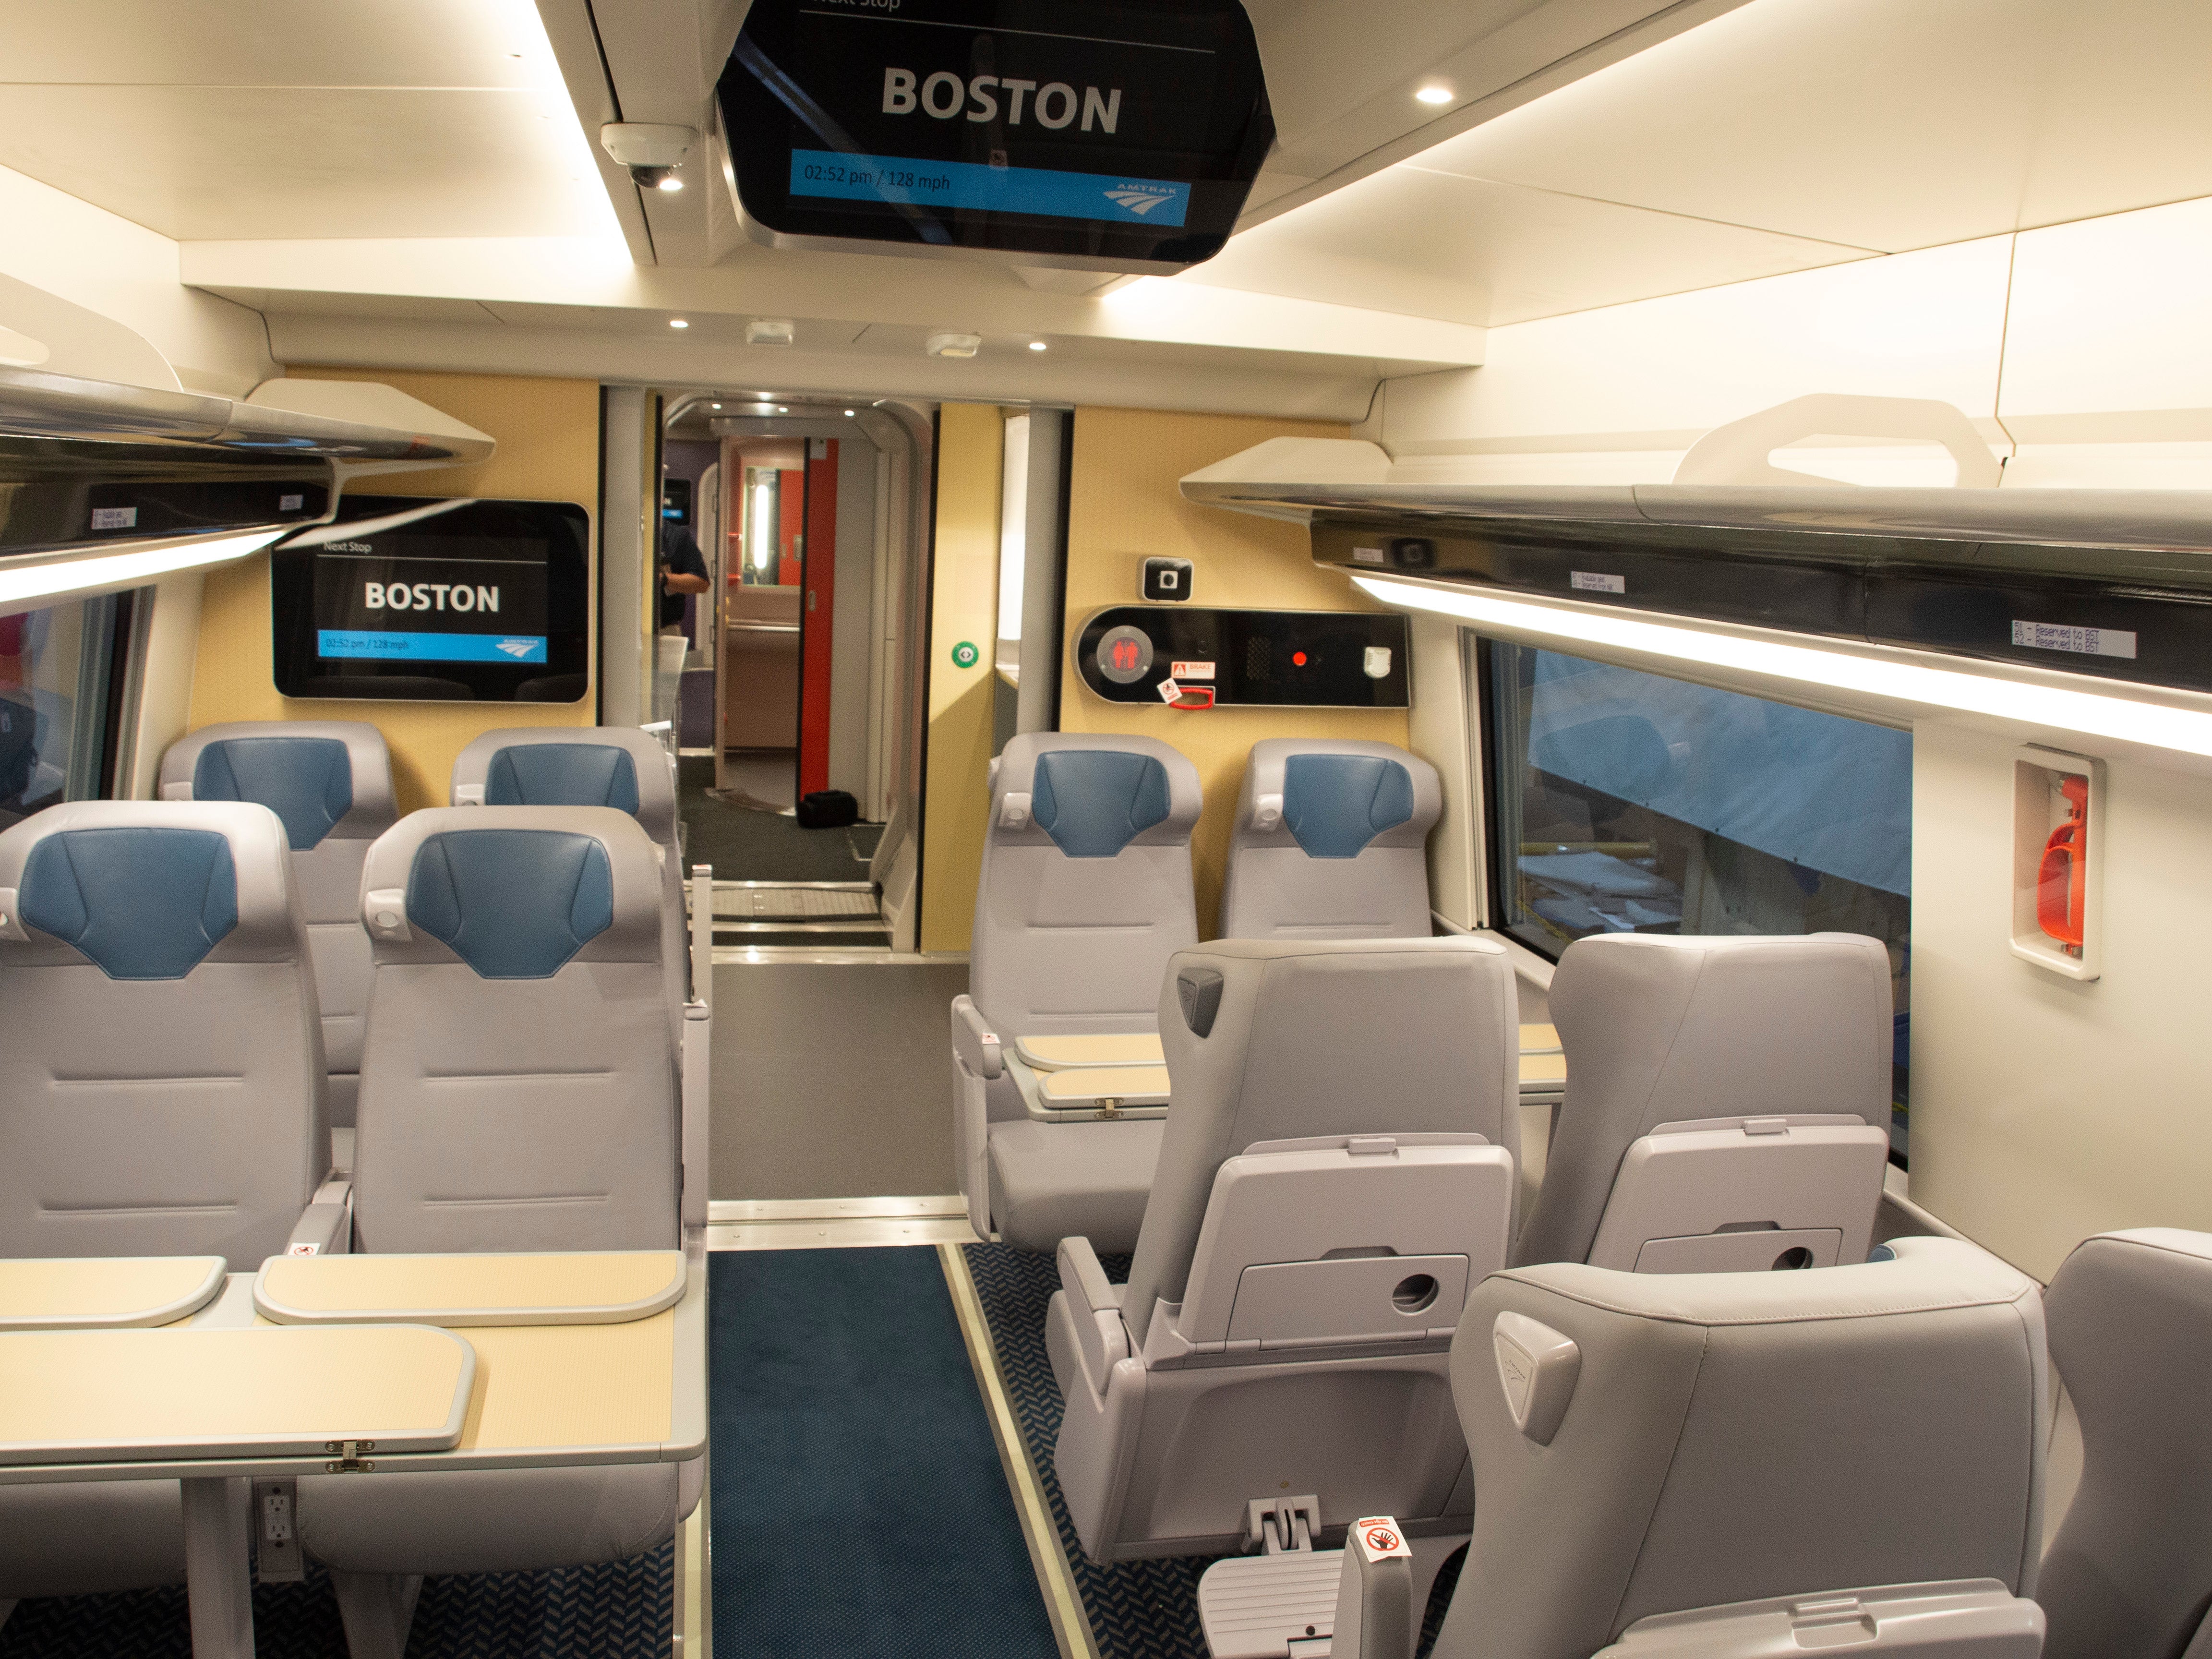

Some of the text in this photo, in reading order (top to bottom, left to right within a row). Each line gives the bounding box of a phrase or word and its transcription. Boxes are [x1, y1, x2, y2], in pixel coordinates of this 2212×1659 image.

[882, 67, 1122, 134] BOSTON
[805, 165, 950, 192] 02:52 pm / 128 mph
[1117, 183, 1177, 193] AMTRAK
[348, 541, 372, 554] Stop
[365, 582, 499, 612] BOSTON
[2014, 622, 2023, 633] 51
[2035, 624, 2070, 638] Reserved
[2073, 628, 2082, 640] to
[2085, 629, 2099, 641] BST
[326, 638, 349, 648] 02:52
[2014, 633, 2024, 644] 52
[2035, 635, 2070, 650] Reserved
[2073, 639, 2082, 651] to
[2085, 640, 2099, 653] BST
